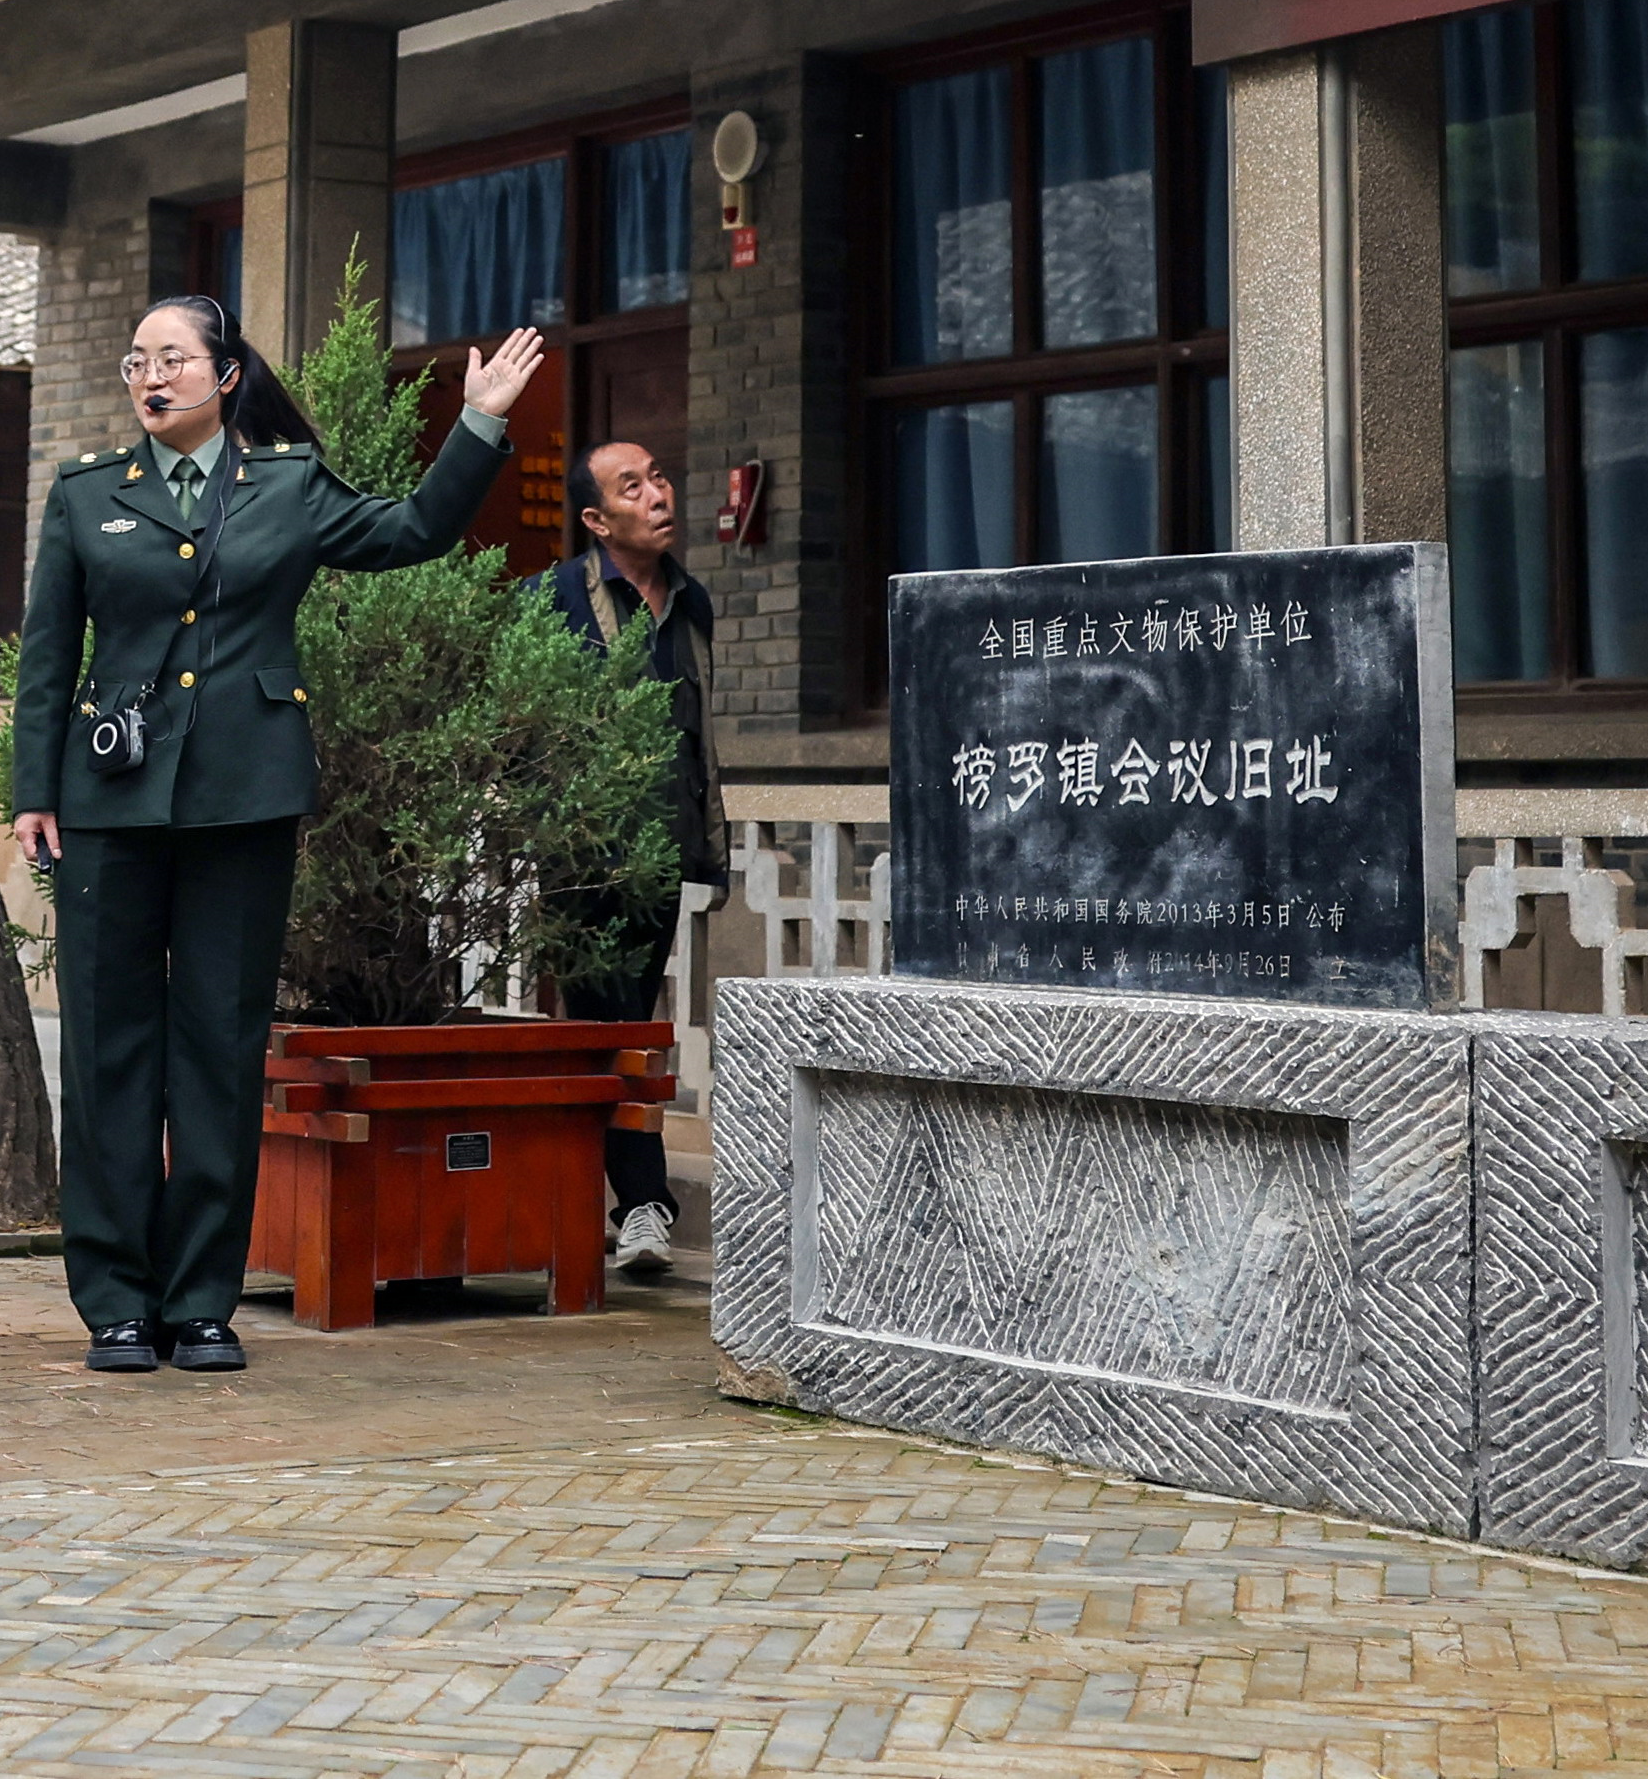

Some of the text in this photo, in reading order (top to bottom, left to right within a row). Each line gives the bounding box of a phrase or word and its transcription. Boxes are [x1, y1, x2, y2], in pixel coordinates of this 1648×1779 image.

[978, 600, 1312, 661] 全国重点文物保护单位
[951, 734, 1339, 813] 榜罗镇会议旧址
